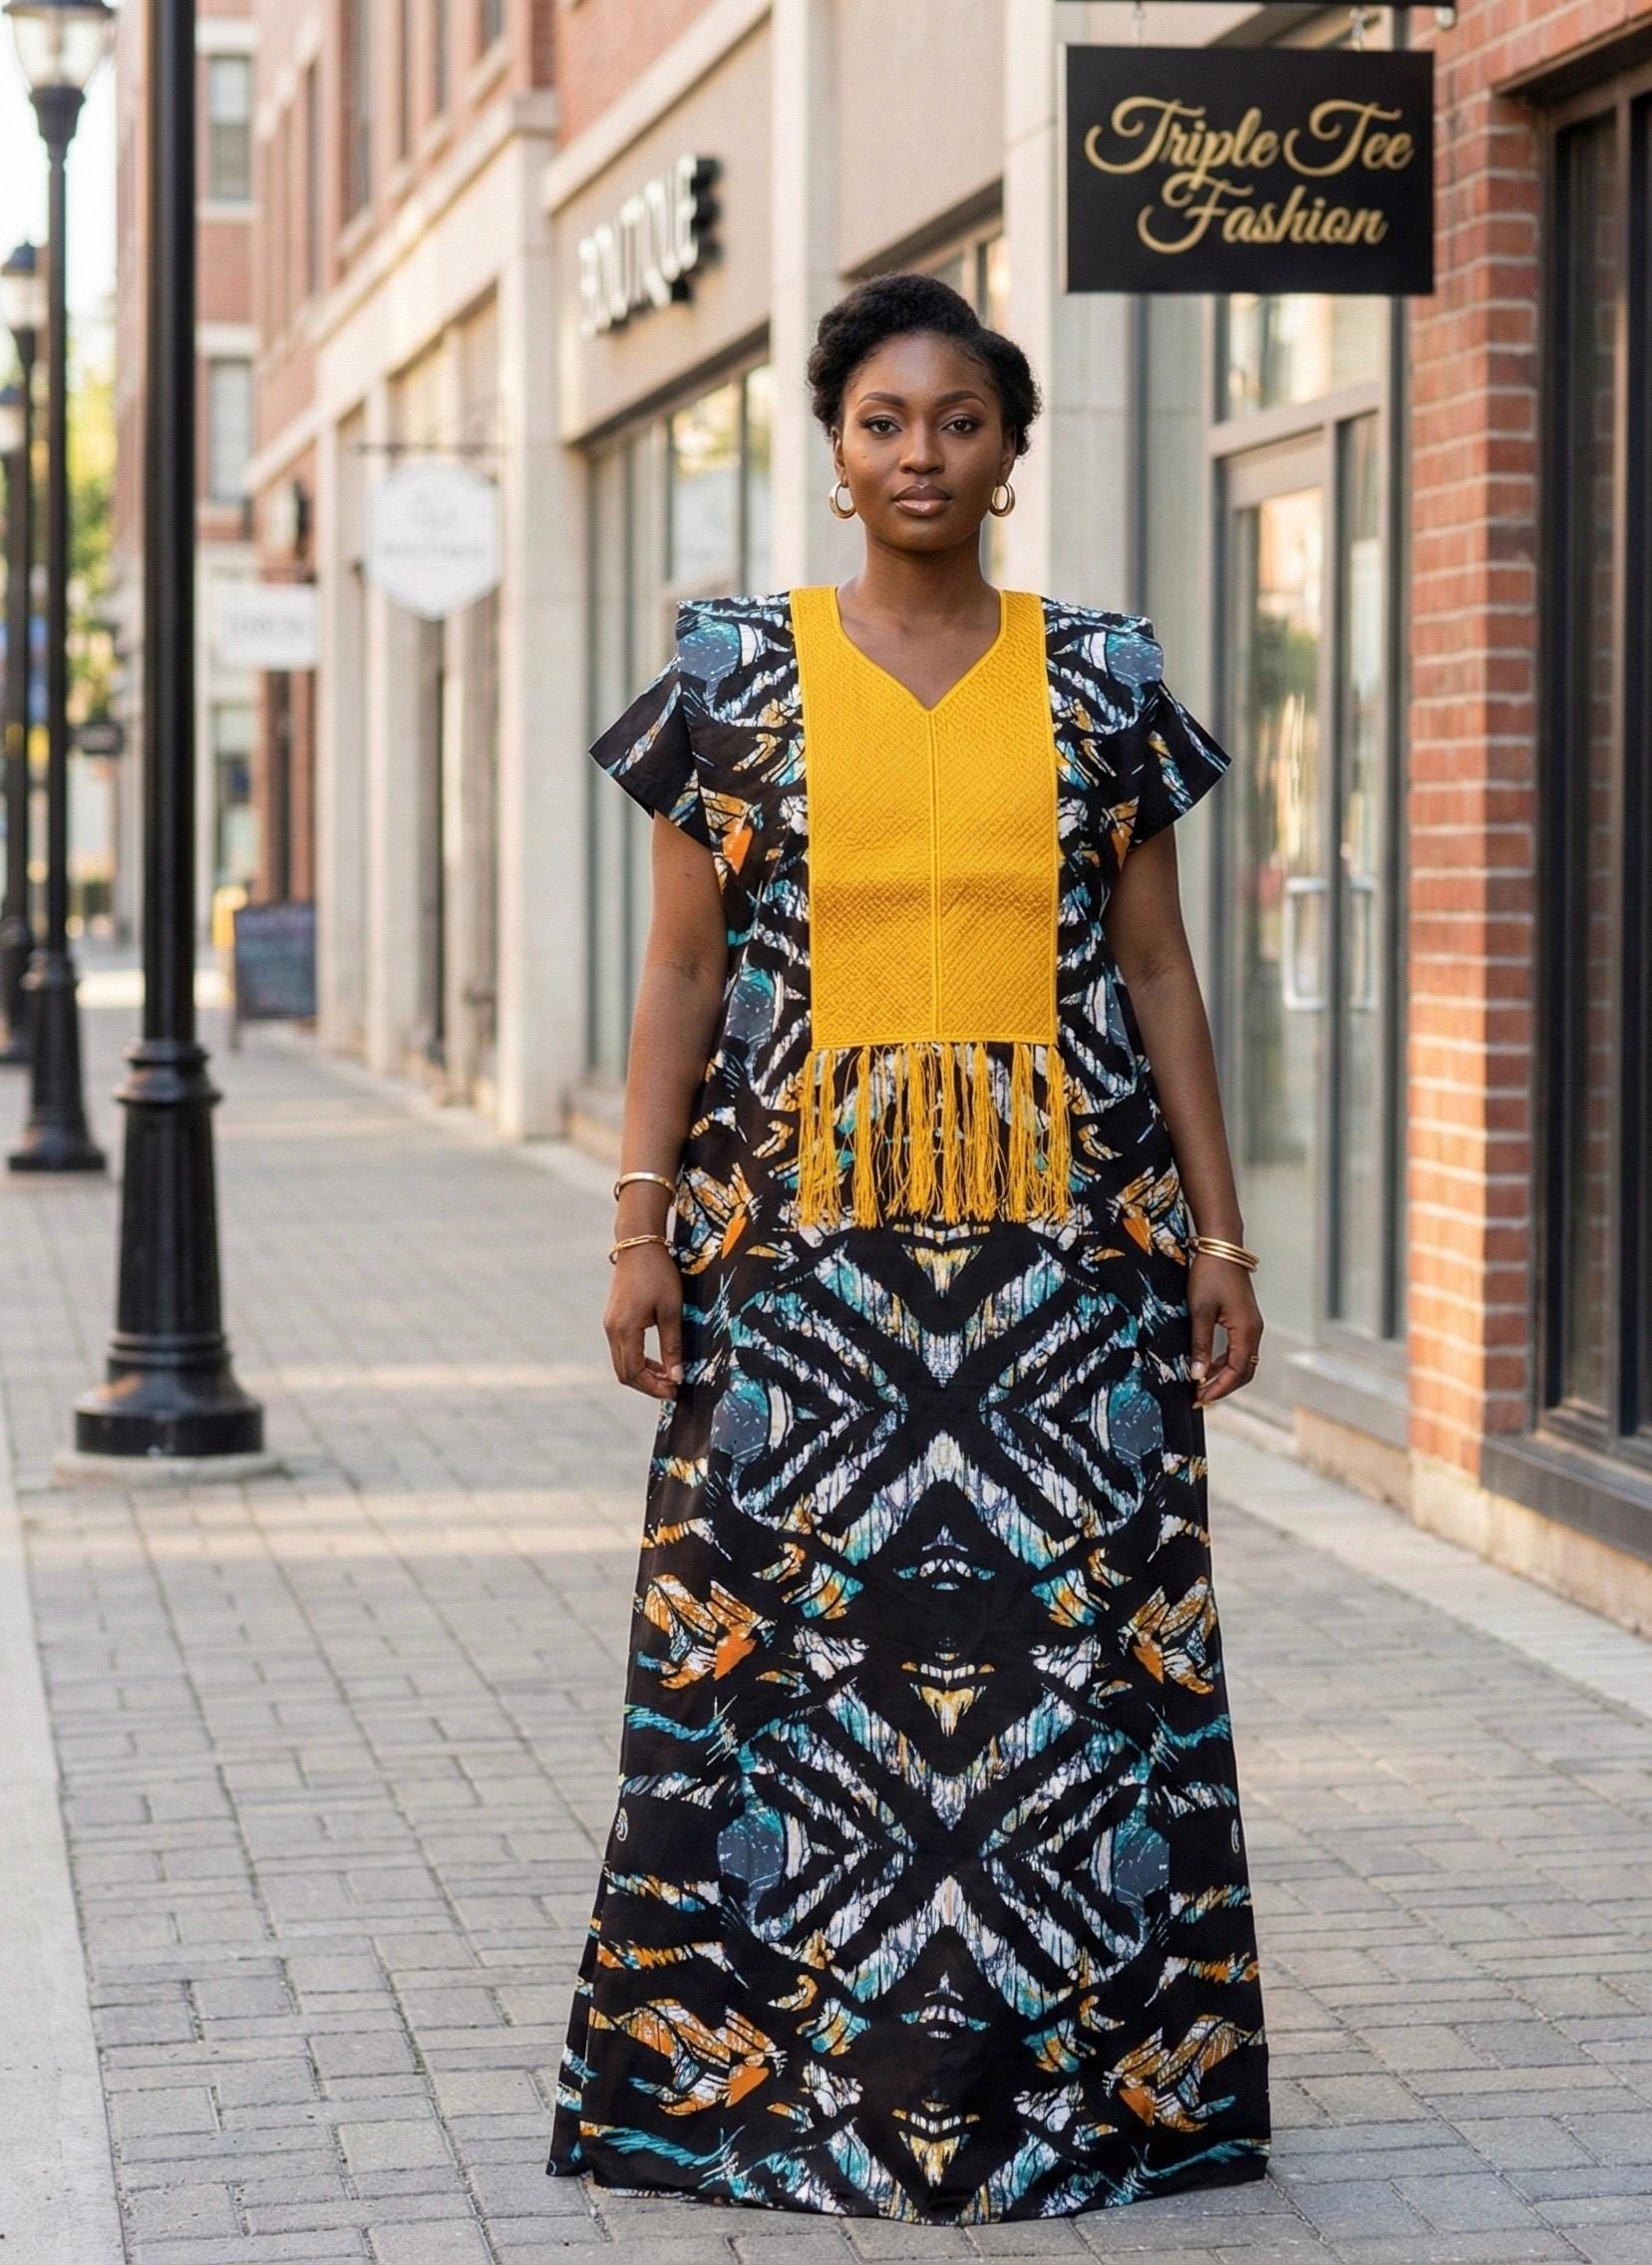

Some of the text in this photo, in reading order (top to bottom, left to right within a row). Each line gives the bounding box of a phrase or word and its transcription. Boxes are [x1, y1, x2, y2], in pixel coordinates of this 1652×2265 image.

[1085, 97, 1415, 186] Triple Tee
[1139, 172, 1387, 253] Fashion
